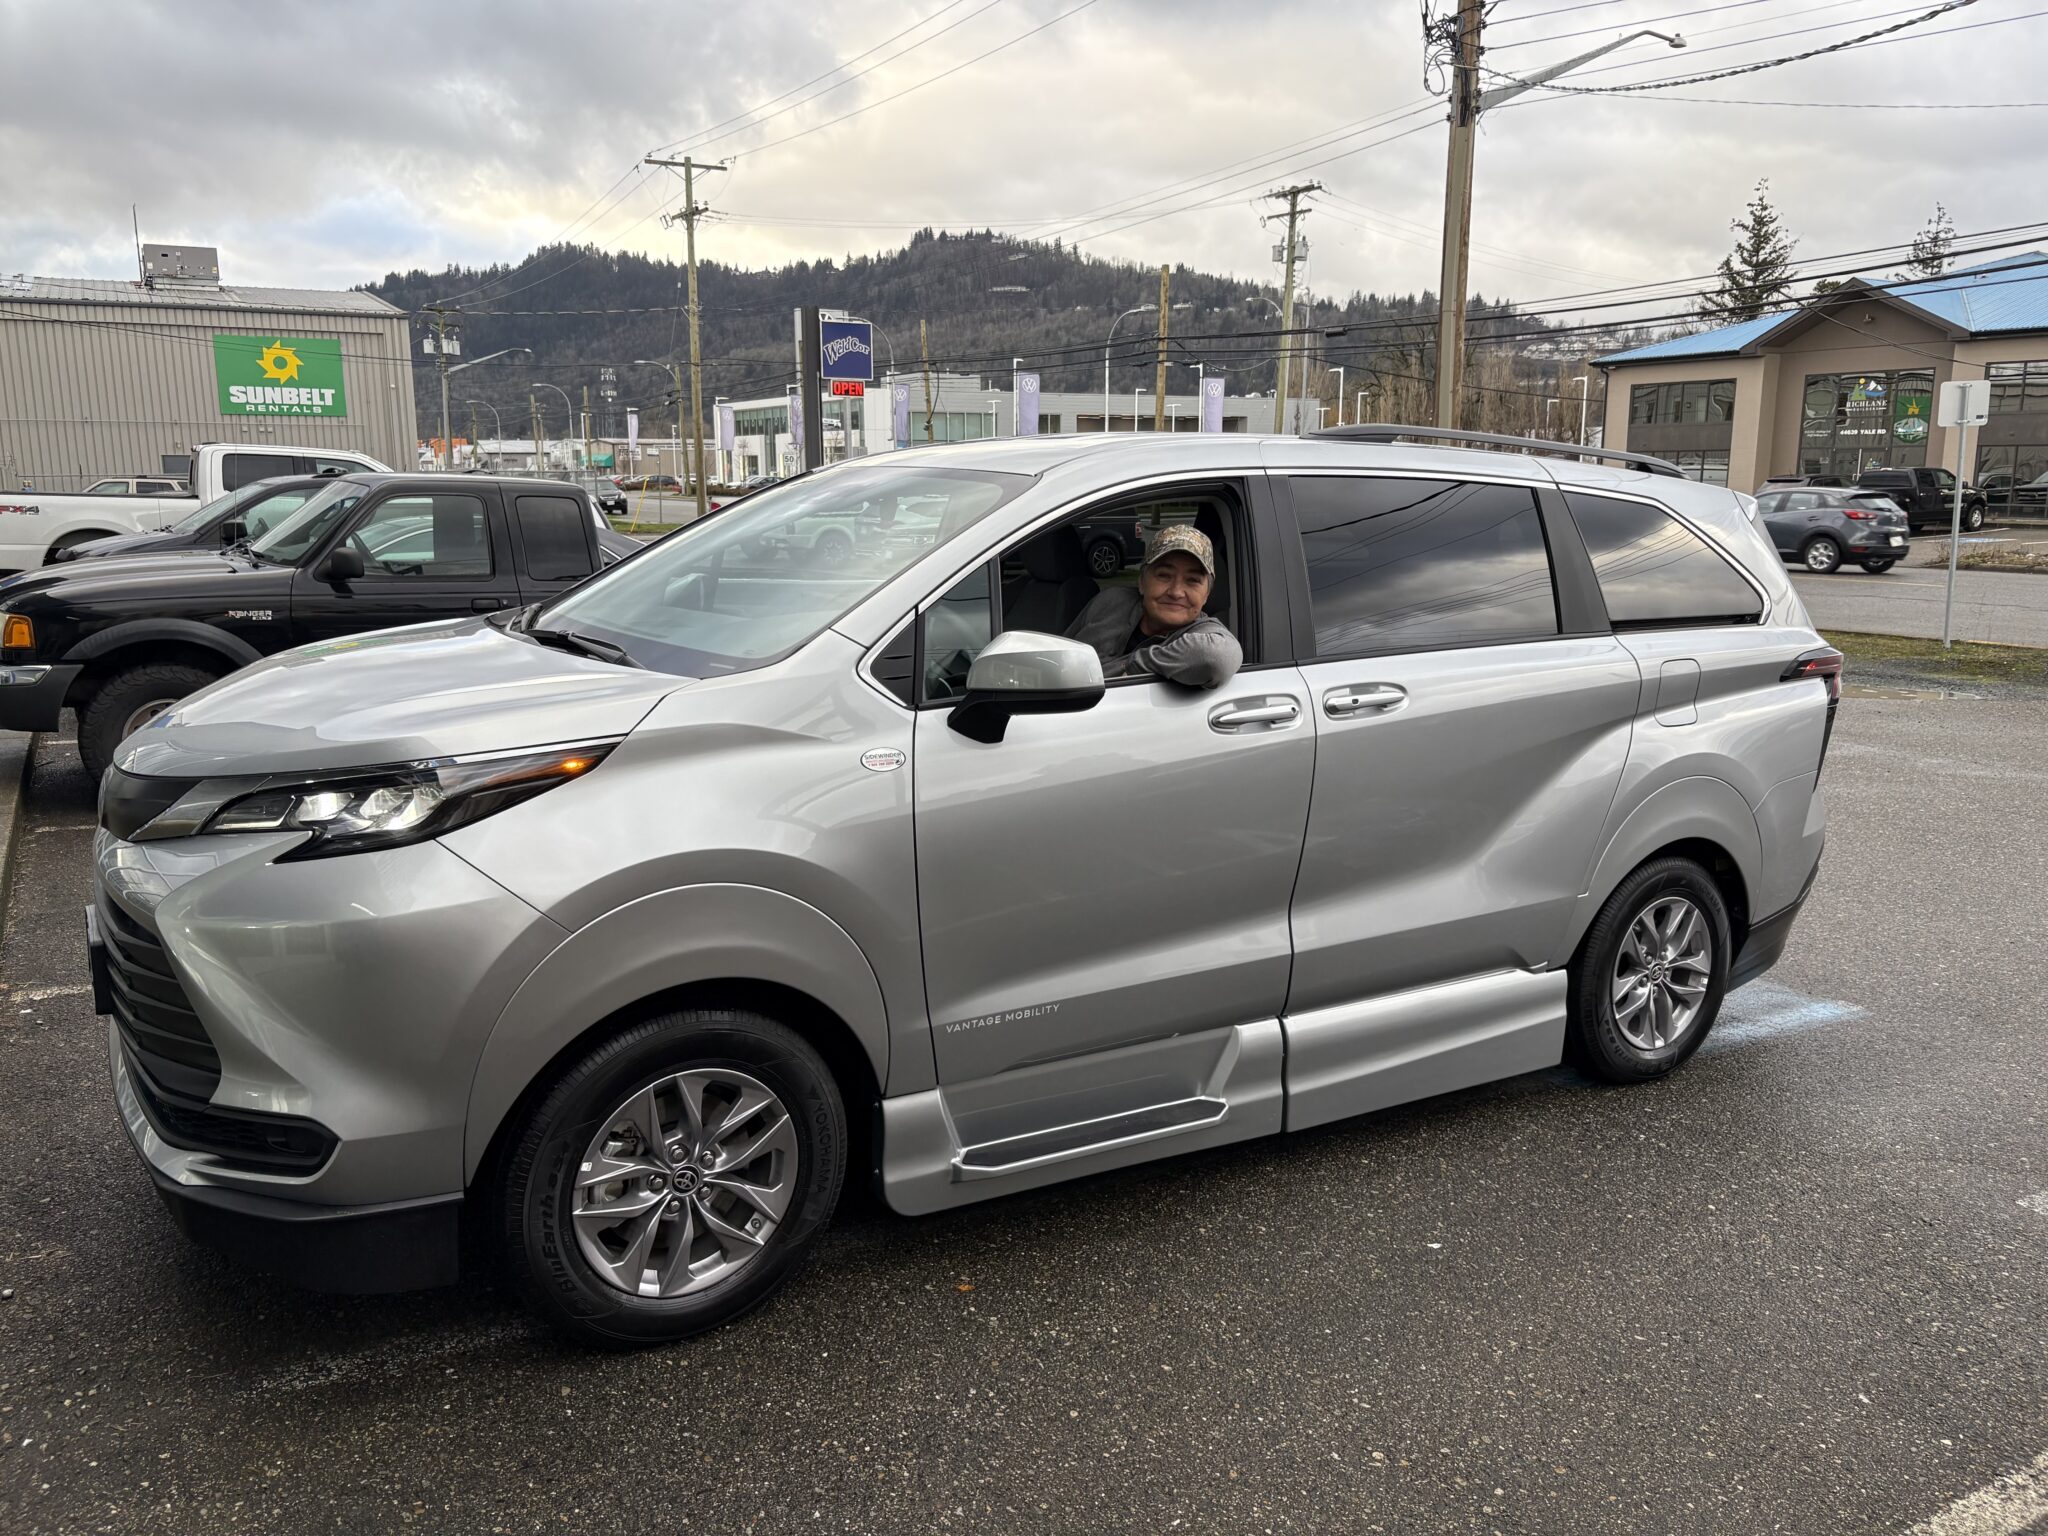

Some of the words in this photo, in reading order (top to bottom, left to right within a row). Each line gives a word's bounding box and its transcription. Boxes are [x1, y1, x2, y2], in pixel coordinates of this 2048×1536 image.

[823, 336, 870, 366] WeldCor
[229, 385, 336, 406] SUNBELT
[833, 381, 864, 395] OPEN
[246, 405, 322, 413] RENTALS
[1846, 399, 1888, 408] RICHLANE
[784, 455, 795, 463] 50
[864, 752, 902, 760] SIDEWINDER
[945, 1015, 1002, 1033] VANTAGE
[1005, 1004, 1061, 1022] MOBILITY
[814, 1102, 834, 1193] YOKOHAMA
[540, 1194, 578, 1293] BluEarth
